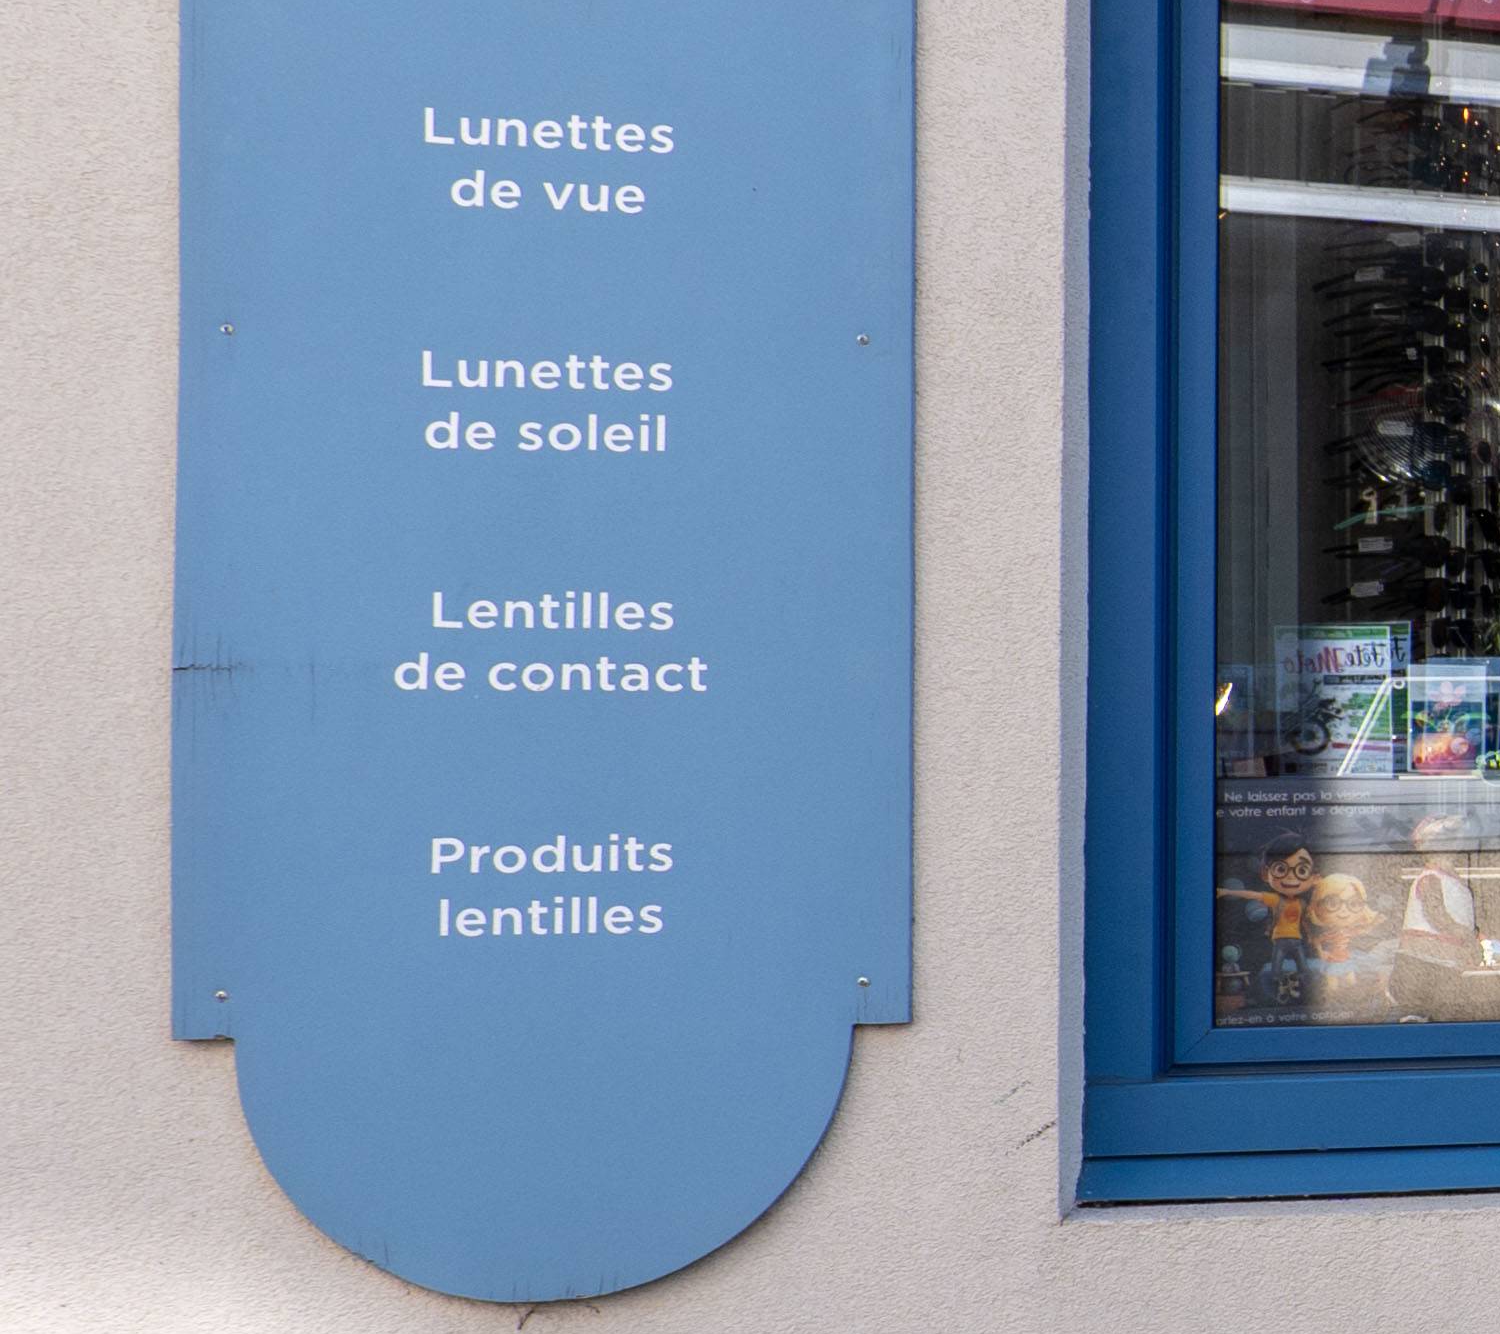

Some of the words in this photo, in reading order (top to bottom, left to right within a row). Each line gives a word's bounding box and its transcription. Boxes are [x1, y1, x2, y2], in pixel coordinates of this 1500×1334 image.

[424, 107, 675, 153] Lunettes
[450, 170, 521, 209] de
[543, 181, 646, 214] vue
[422, 350, 673, 392] Lunettes
[425, 412, 496, 451] de
[517, 414, 667, 452] soleil
[432, 592, 674, 630] Lentilles
[394, 652, 465, 691] de
[488, 657, 708, 692] contact
[1224, 792, 1243, 803] Ne
[1248, 791, 1288, 802] laissez
[1293, 791, 1315, 803] pas
[1230, 807, 1262, 818] votre
[1266, 805, 1306, 817] enfant
[431, 833, 674, 873] Produits
[439, 897, 664, 936] lentilles
[1216, 1015, 1262, 1026] arlez-en
